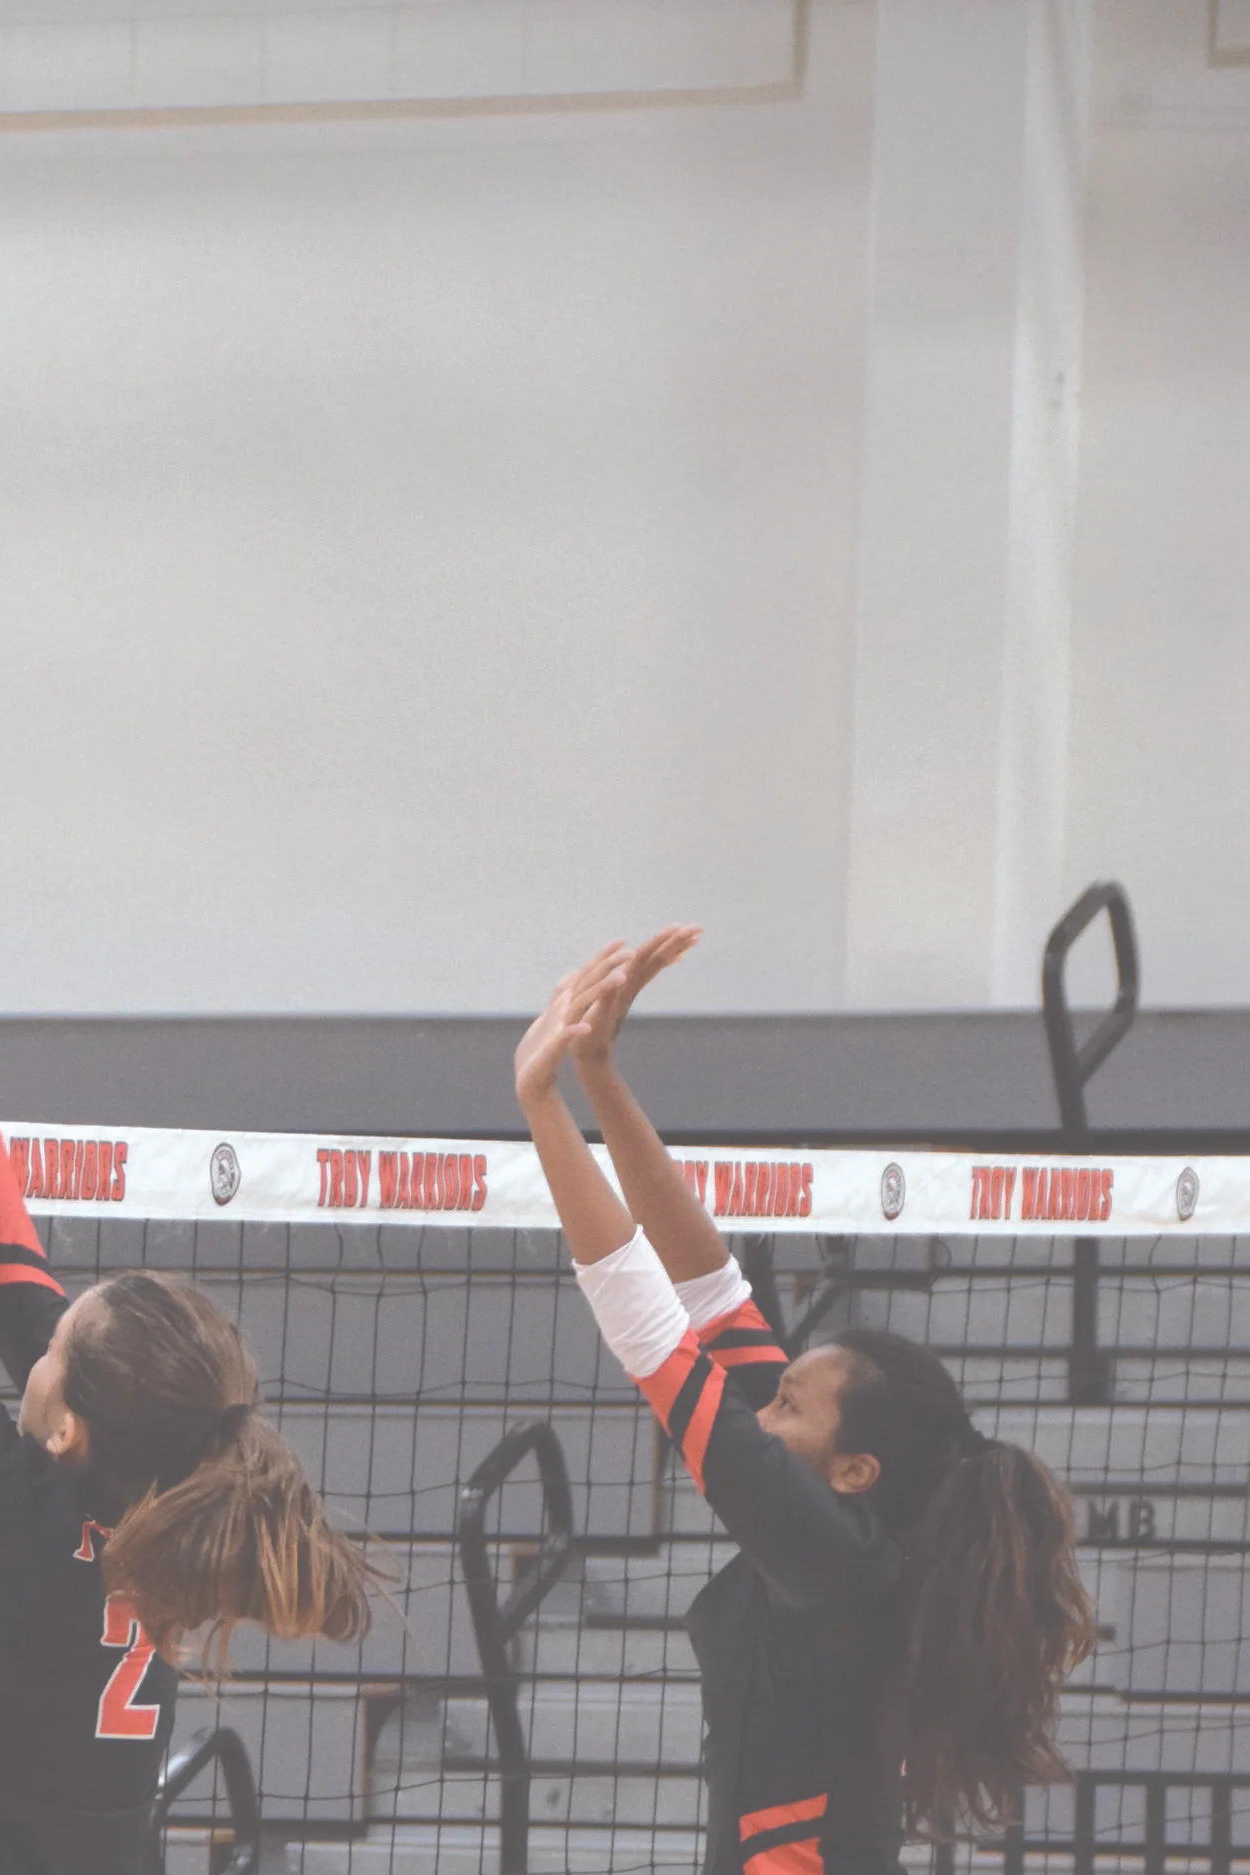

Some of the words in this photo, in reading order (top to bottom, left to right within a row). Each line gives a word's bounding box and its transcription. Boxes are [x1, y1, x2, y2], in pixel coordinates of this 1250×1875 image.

[317, 1149, 371, 1208] TROY
[379, 1151, 487, 1211] WARRIORS
[713, 1161, 813, 1217] WARRIORS
[970, 1166, 1017, 1220] TROY
[1021, 1167, 1114, 1221] WARRIORS
[95, 1591, 160, 1738] 2
